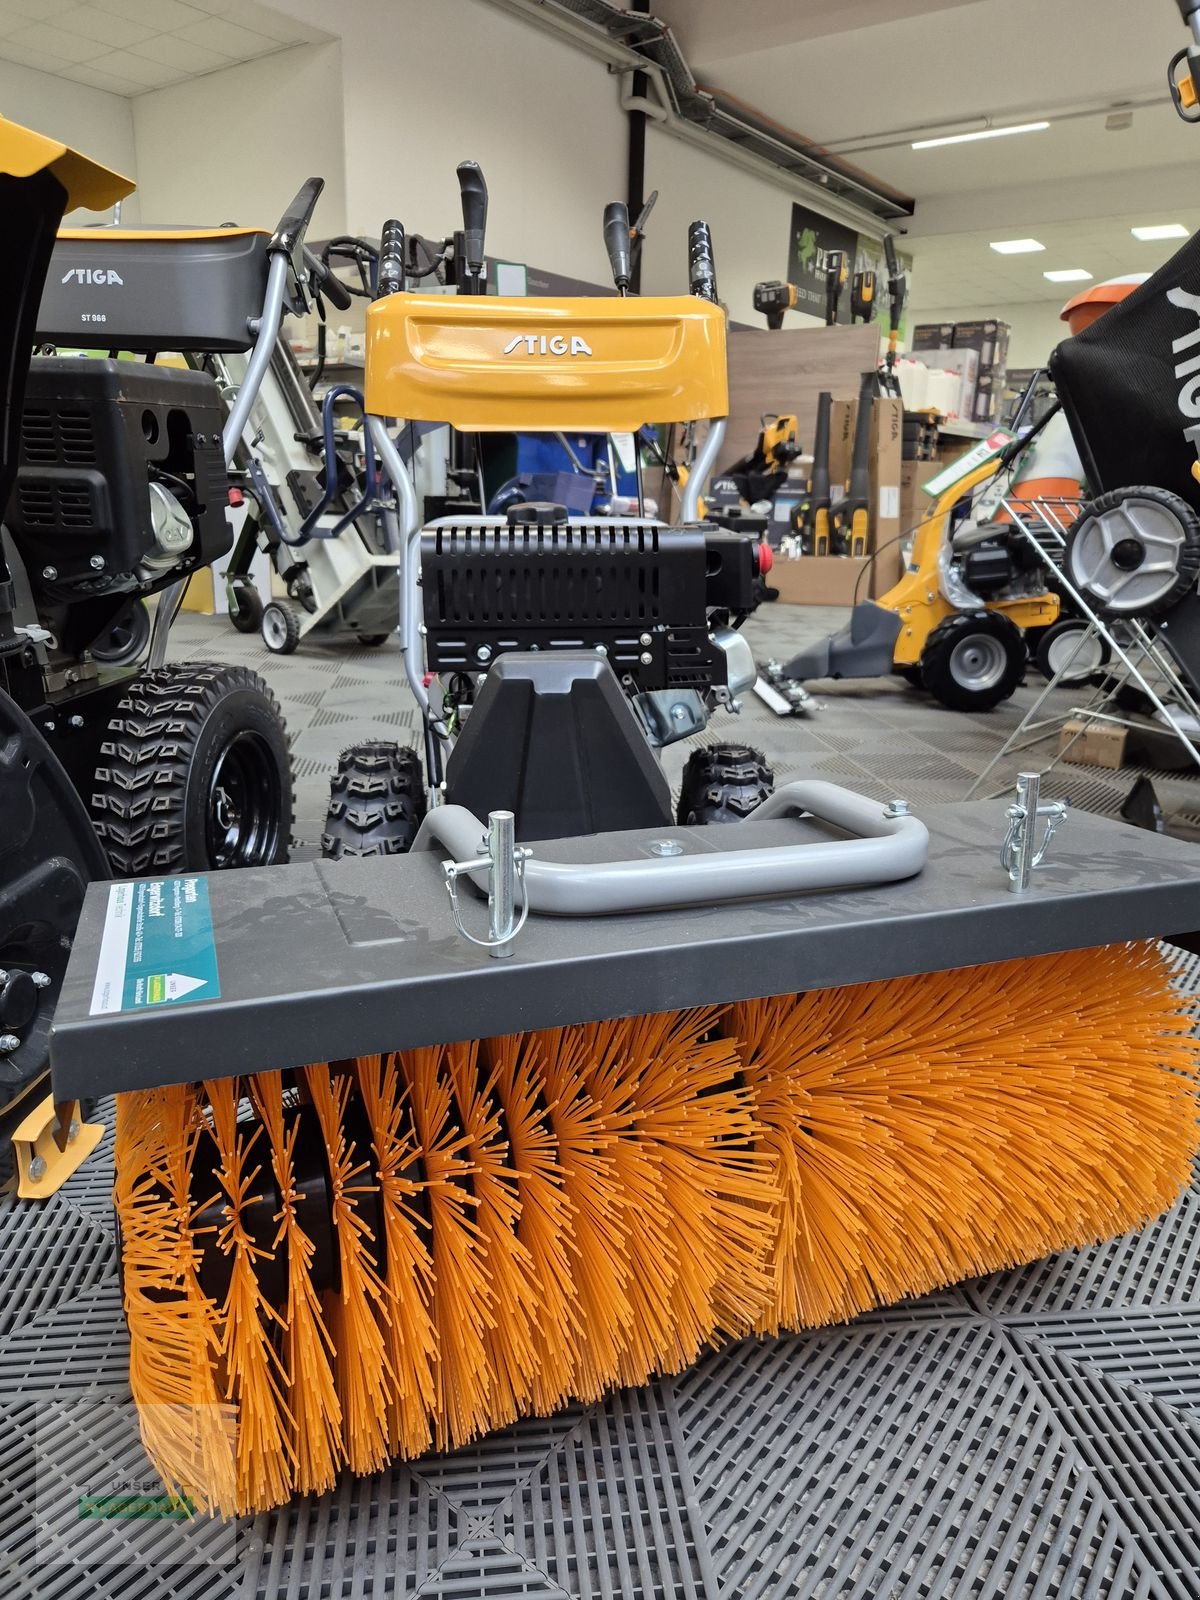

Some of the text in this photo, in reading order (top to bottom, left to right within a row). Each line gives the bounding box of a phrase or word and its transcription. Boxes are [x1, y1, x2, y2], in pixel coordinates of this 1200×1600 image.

[61, 268, 124, 286] STIGA
[504, 335, 592, 356] STIGA
[891, 403, 899, 441] STIGA
[714, 480, 738, 490] STIG
